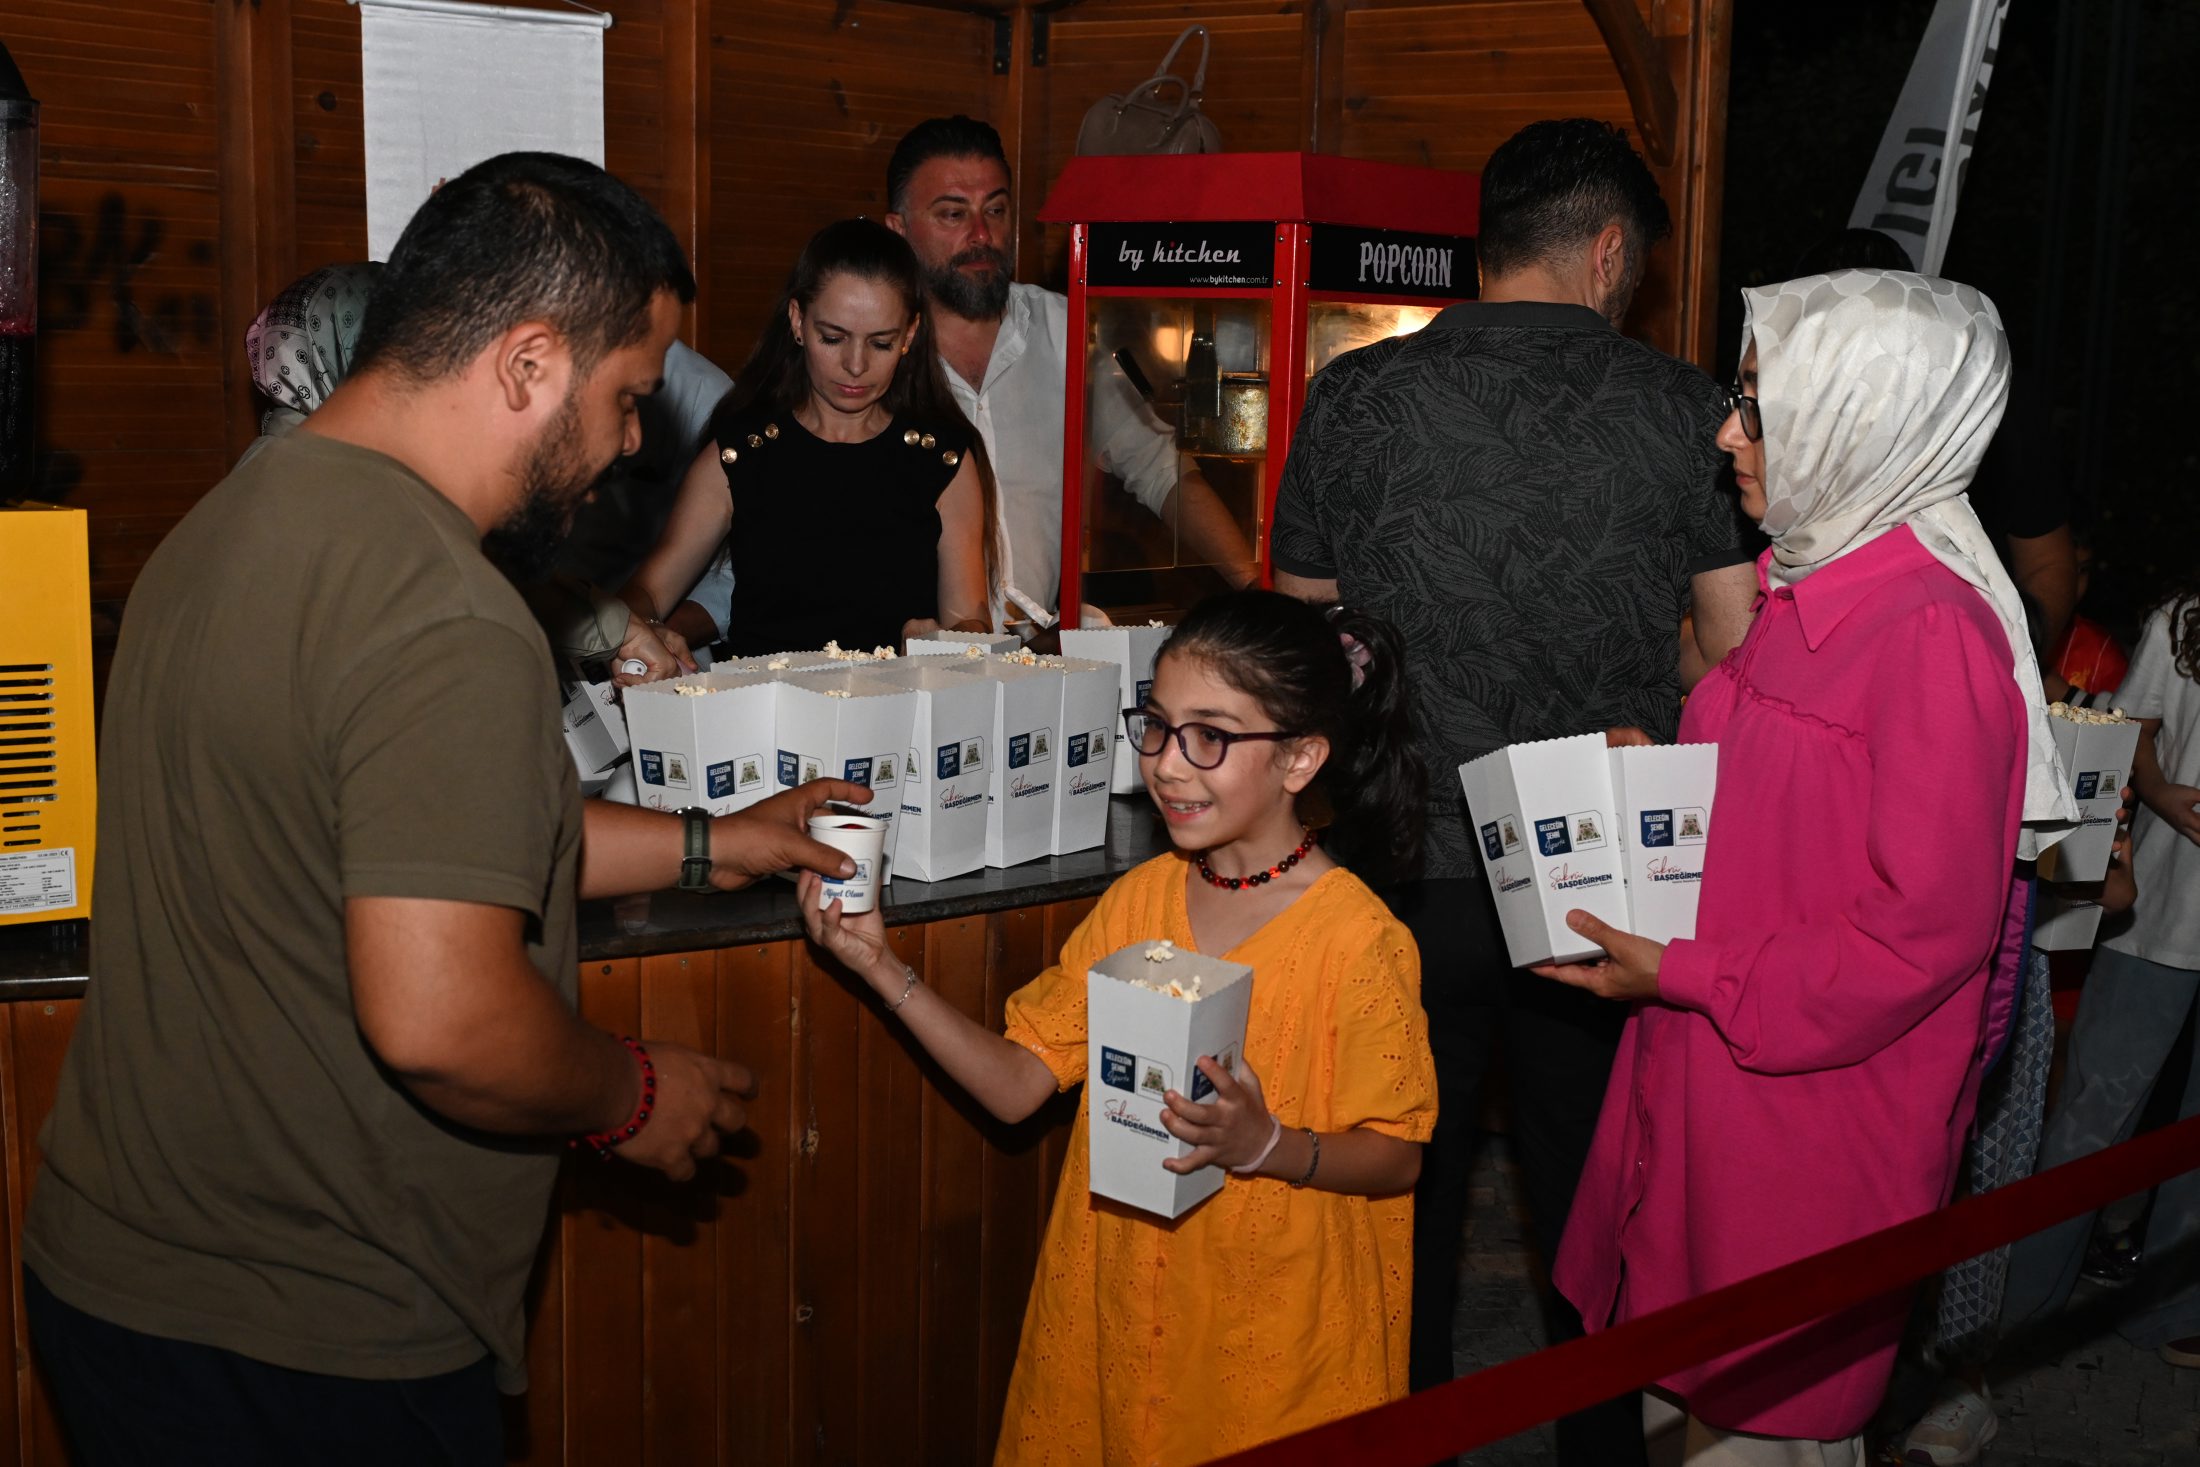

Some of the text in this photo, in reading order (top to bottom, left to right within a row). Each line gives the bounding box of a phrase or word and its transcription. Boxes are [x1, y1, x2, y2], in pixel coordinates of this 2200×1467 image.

[1118, 240, 1241, 271] by kitchen
[1358, 241, 1453, 288] POPCORN
[1189, 274, 1269, 284] www.bykitchen.com.tr
[1550, 863, 1584, 890] Şükrü
[1558, 873, 1612, 890] BAŞDEĞİRMEN
[1654, 872, 1703, 882] BAŞDEĞİRME
[1111, 1115, 1169, 1140] BAŞDEĞİRMEN
